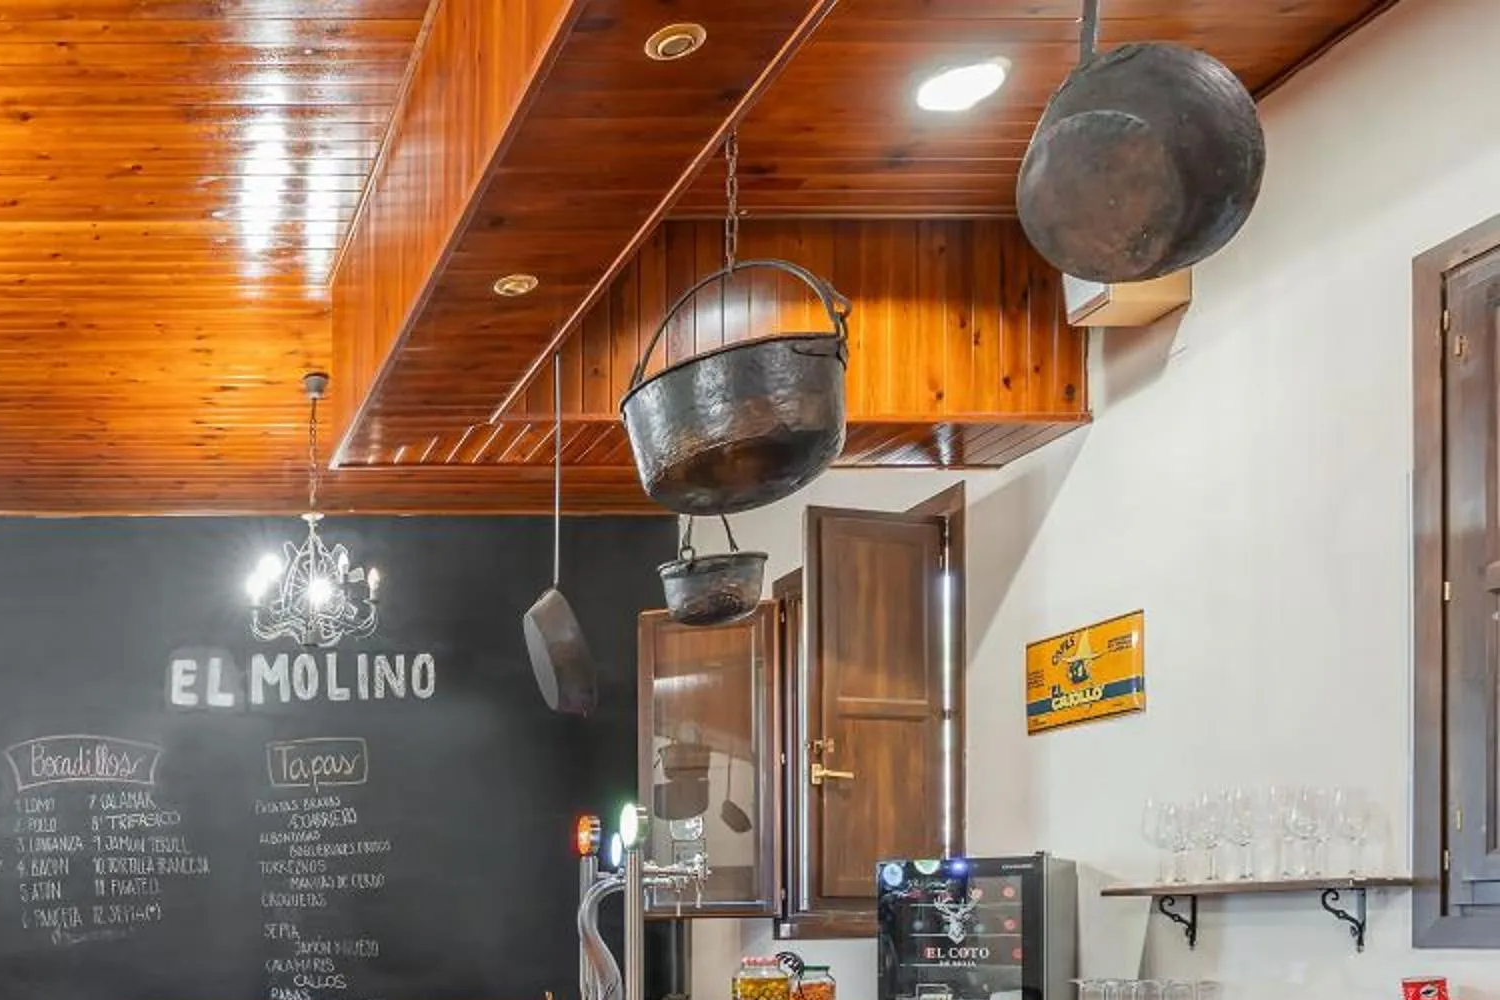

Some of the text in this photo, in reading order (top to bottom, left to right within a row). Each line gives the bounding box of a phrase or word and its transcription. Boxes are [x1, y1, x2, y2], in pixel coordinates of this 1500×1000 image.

[171, 652, 436, 707] EL MOLINO
[31, 743, 147, 777] Bocadillos
[273, 745, 361, 793] Tapas
[926, 947, 990, 959] EL COTO
[293, 972, 347, 989] CALLOS
